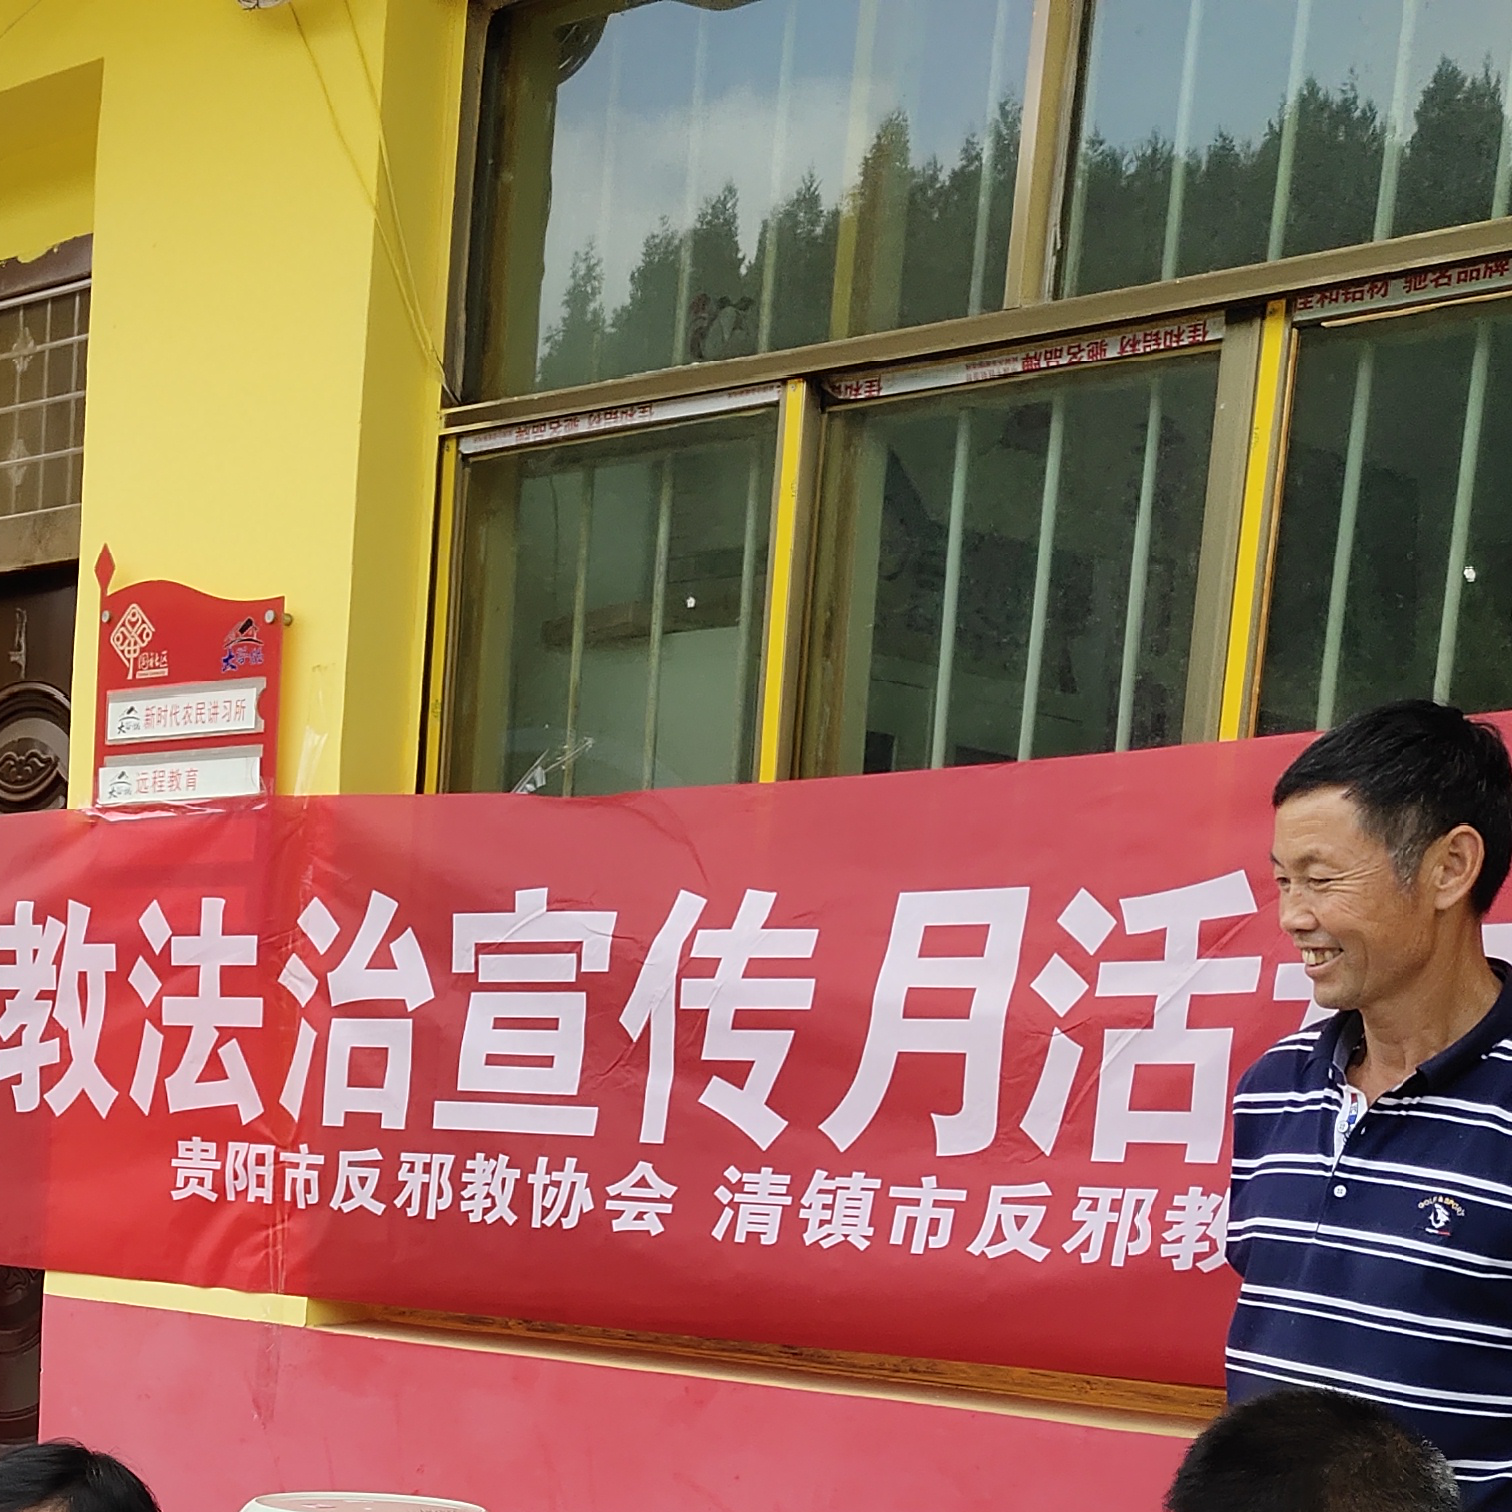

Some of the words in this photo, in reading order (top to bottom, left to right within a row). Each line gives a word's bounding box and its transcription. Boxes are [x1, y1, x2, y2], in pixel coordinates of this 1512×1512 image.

[1403, 258, 1510, 294] 驰名品牌
[1021, 339, 1110, 372] 驰名品牌
[1117, 320, 1209, 356] 佳和铝材
[144, 698, 246, 728] 新时代农民讲习所
[135, 768, 199, 794] 远程教育
[170, 1135, 679, 1237] 贵阳市反邪教协会
[711, 1163, 1231, 1275] 清镇市反邪教
